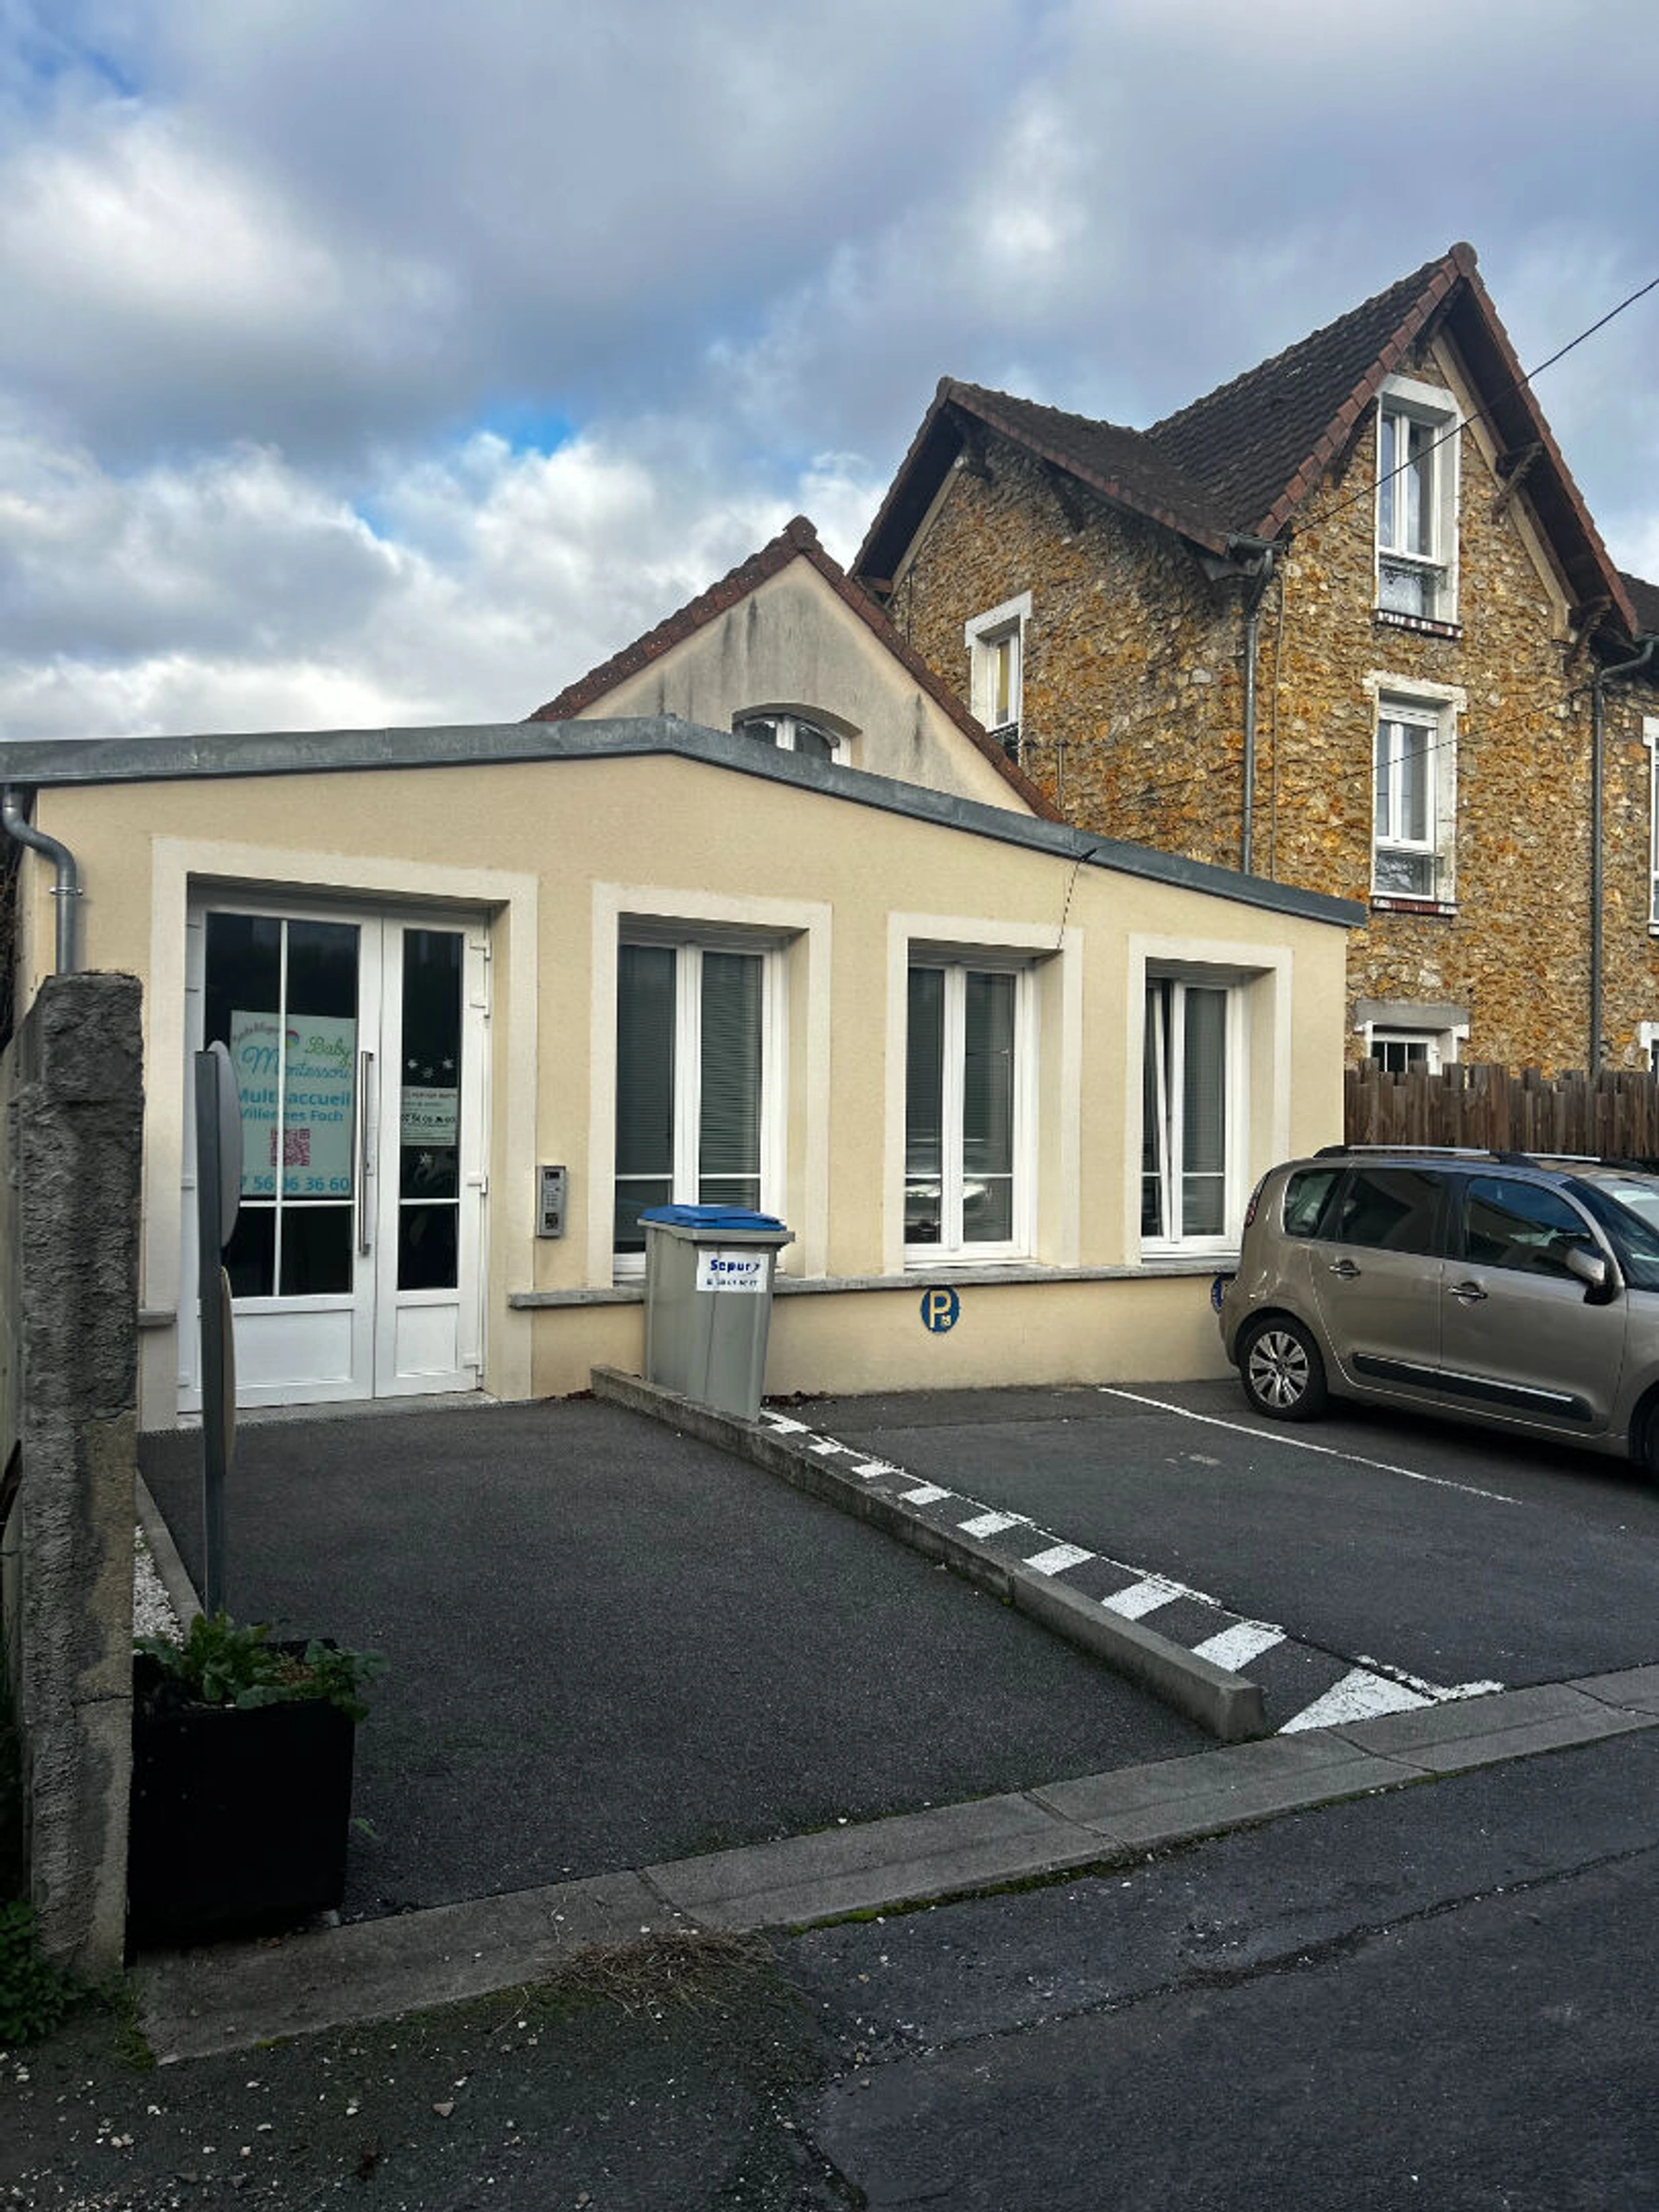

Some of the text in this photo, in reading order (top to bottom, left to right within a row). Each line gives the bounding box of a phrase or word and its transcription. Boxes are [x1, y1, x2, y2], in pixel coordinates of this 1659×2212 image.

[305, 1036, 351, 1068] Baby
[310, 1109, 343, 1122] Foch
[253, 1176, 275, 1191] 56
[305, 1178, 326, 1192] 36
[329, 1178, 350, 1192] 60
[710, 1259, 751, 1273] Sepur
[930, 1290, 951, 1328] P
